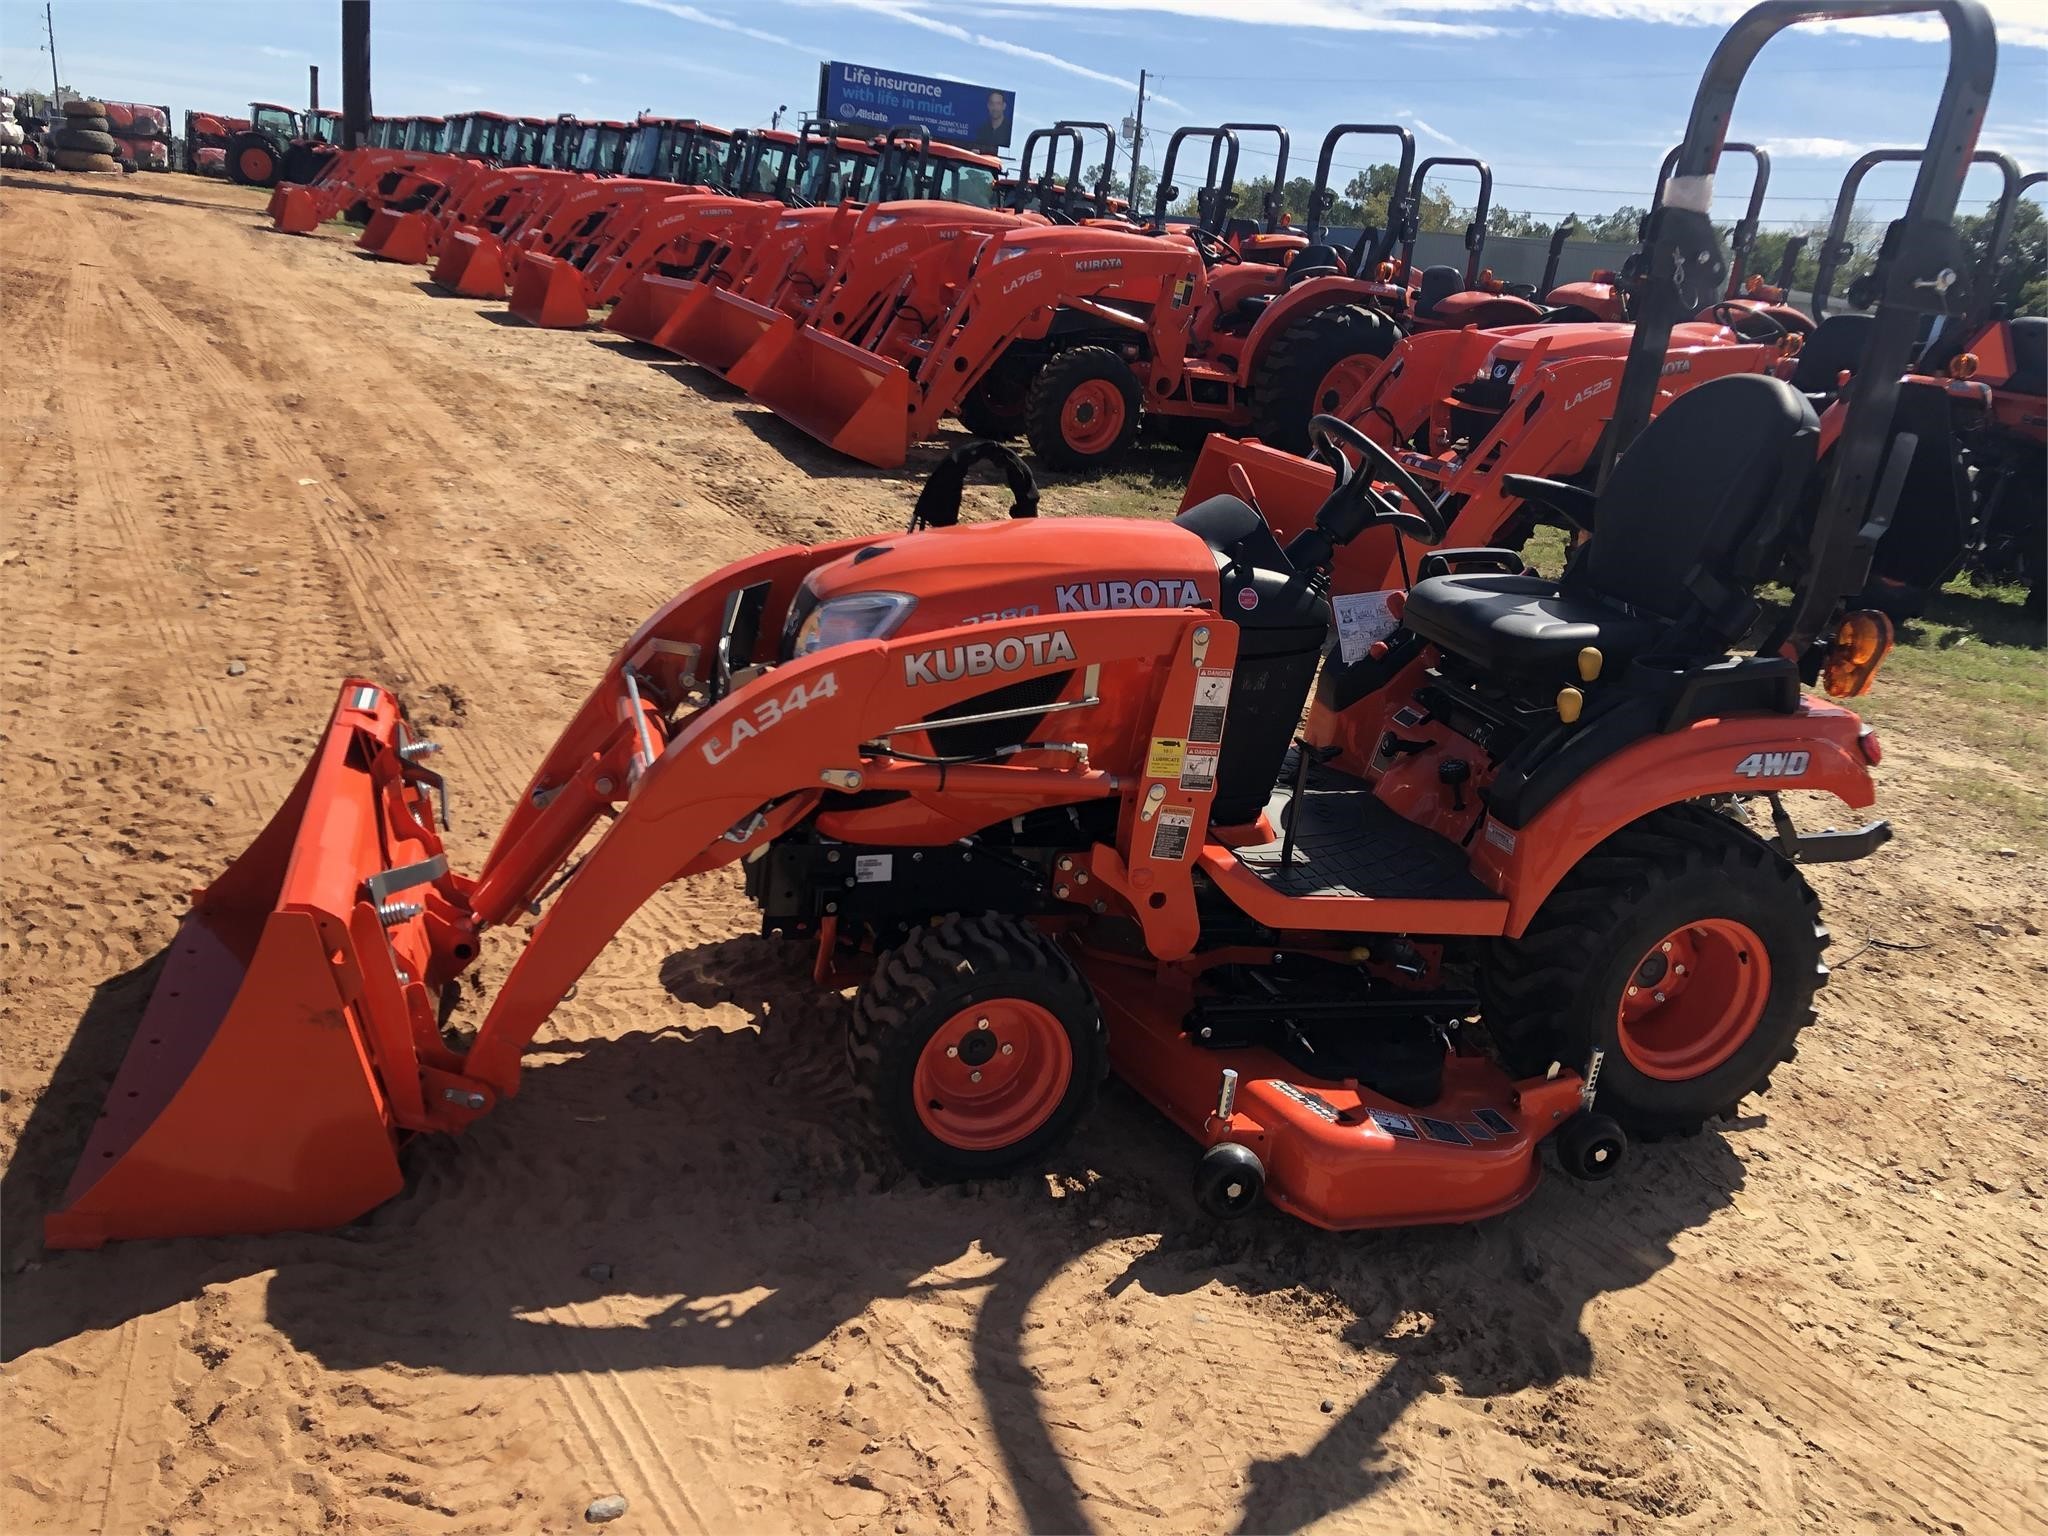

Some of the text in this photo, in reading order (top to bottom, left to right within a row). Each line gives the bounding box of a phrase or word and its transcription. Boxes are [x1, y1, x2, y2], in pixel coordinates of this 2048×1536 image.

[843, 65, 942, 98] Life insurance
[842, 86, 955, 117] with life in mind.
[855, 108, 888, 122] Allstate
[873, 241, 909, 265] LA765
[1075, 257, 1123, 272] KUBOTA
[1002, 268, 1043, 295] LA765
[1661, 359, 1691, 376] OTA
[1563, 377, 1613, 411] LA525
[1055, 579, 1201, 613] KUBOTA
[904, 629, 1078, 687] KUBOTA
[701, 671, 839, 766] LA344
[1735, 751, 1811, 778] 4WD
